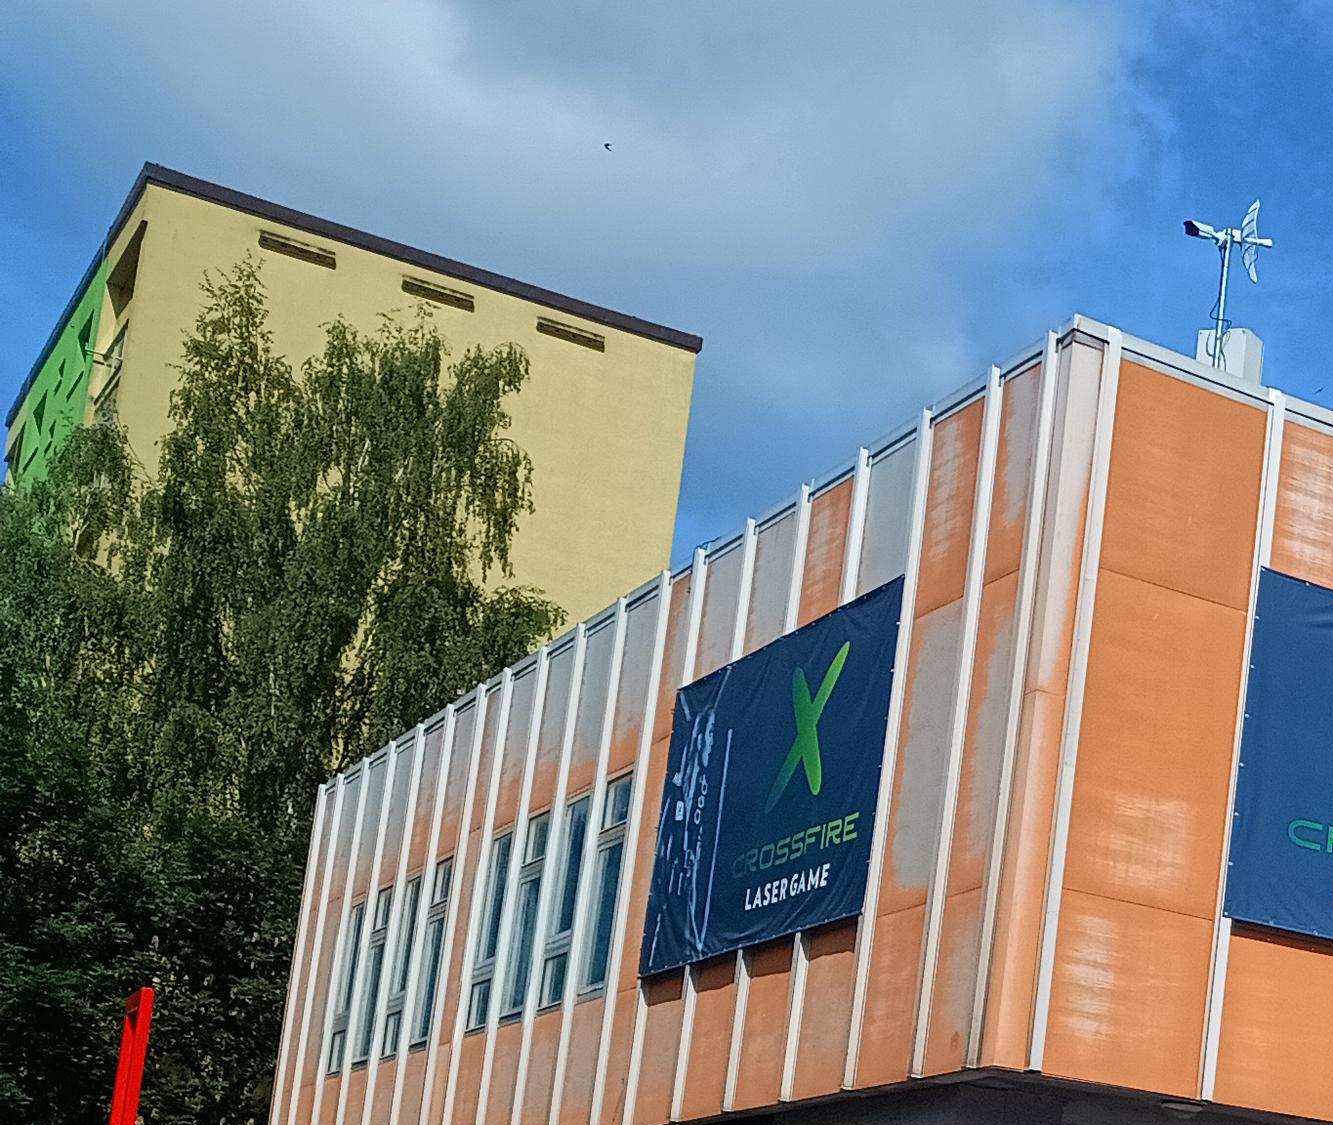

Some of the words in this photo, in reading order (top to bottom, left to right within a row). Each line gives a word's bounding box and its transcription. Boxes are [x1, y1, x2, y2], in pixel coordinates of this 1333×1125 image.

[733, 811, 860, 879] CROSSFIRE
[744, 878, 787, 911] LASER
[789, 863, 831, 898] GAME
